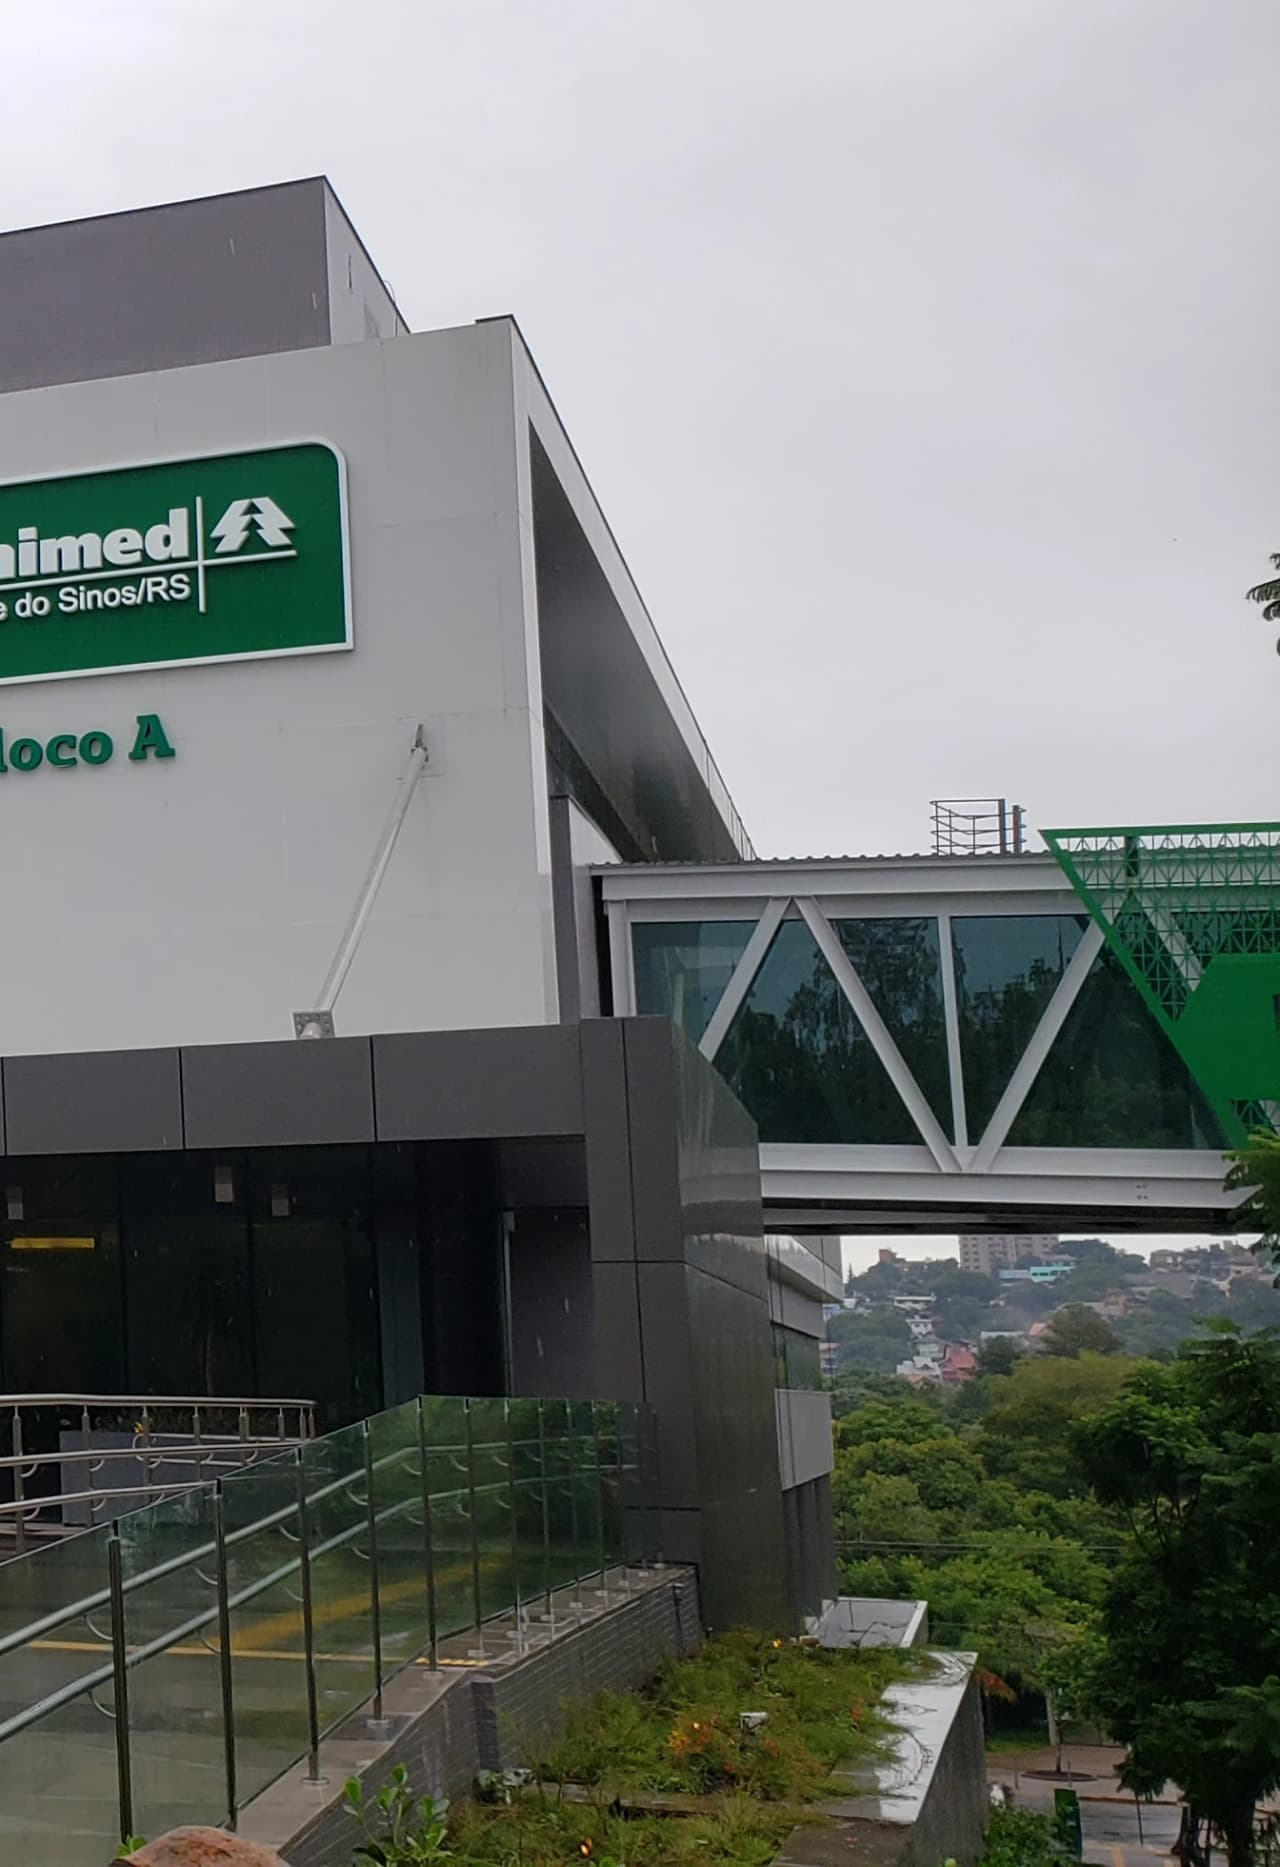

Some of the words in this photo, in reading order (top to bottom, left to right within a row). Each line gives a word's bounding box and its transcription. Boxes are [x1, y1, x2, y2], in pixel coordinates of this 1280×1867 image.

[14, 591, 50, 618] do
[58, 573, 192, 613] Sinos/RS
[128, 713, 177, 762] A
